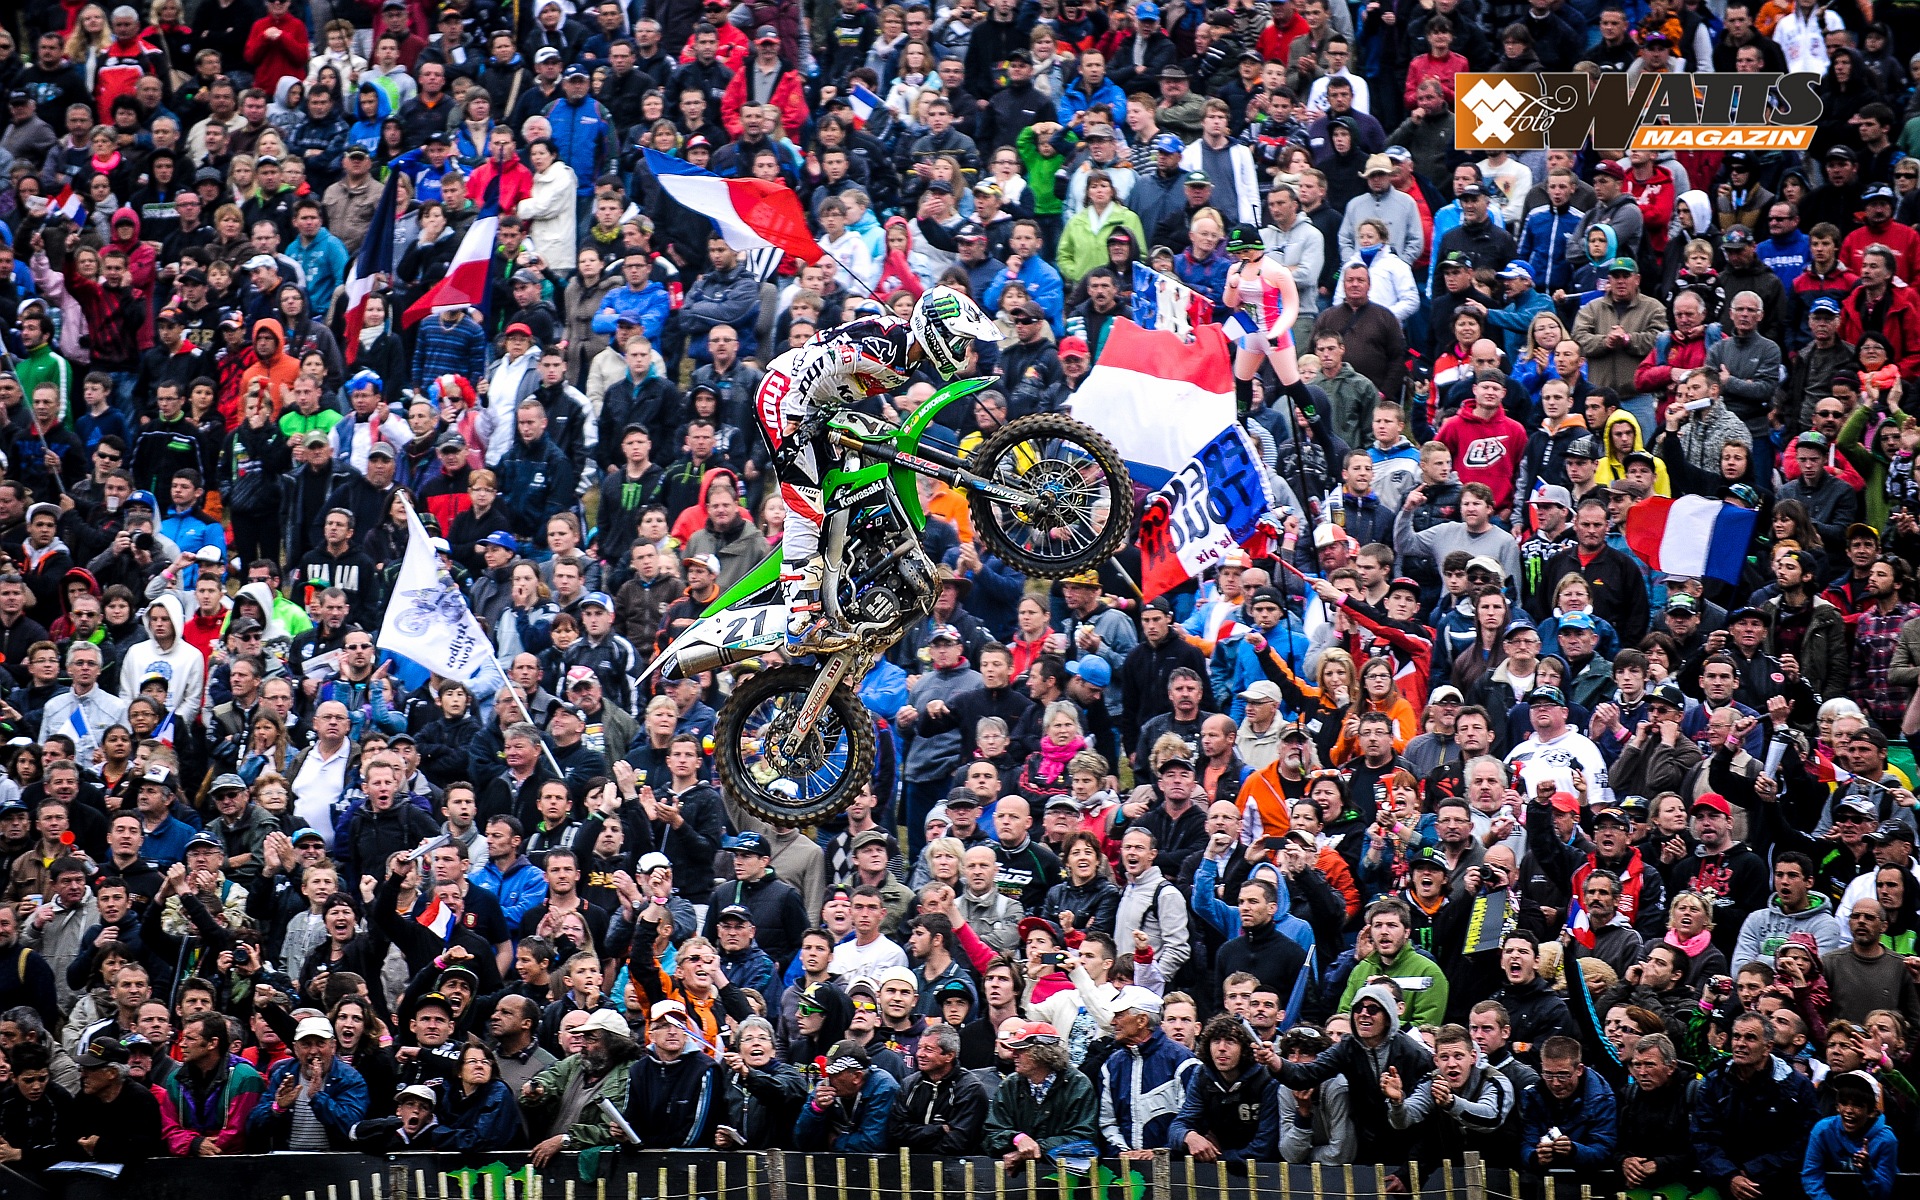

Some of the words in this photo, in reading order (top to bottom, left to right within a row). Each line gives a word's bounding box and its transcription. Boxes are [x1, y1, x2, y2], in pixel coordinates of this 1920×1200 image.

[762, 371, 787, 440] thor
[918, 391, 951, 418] MOTOREX
[797, 486, 821, 496] thor
[838, 479, 885, 508] Kawasaki
[983, 485, 1030, 503] DUNLOP
[722, 609, 768, 645] 21
[747, 632, 778, 648] MOTOREX
